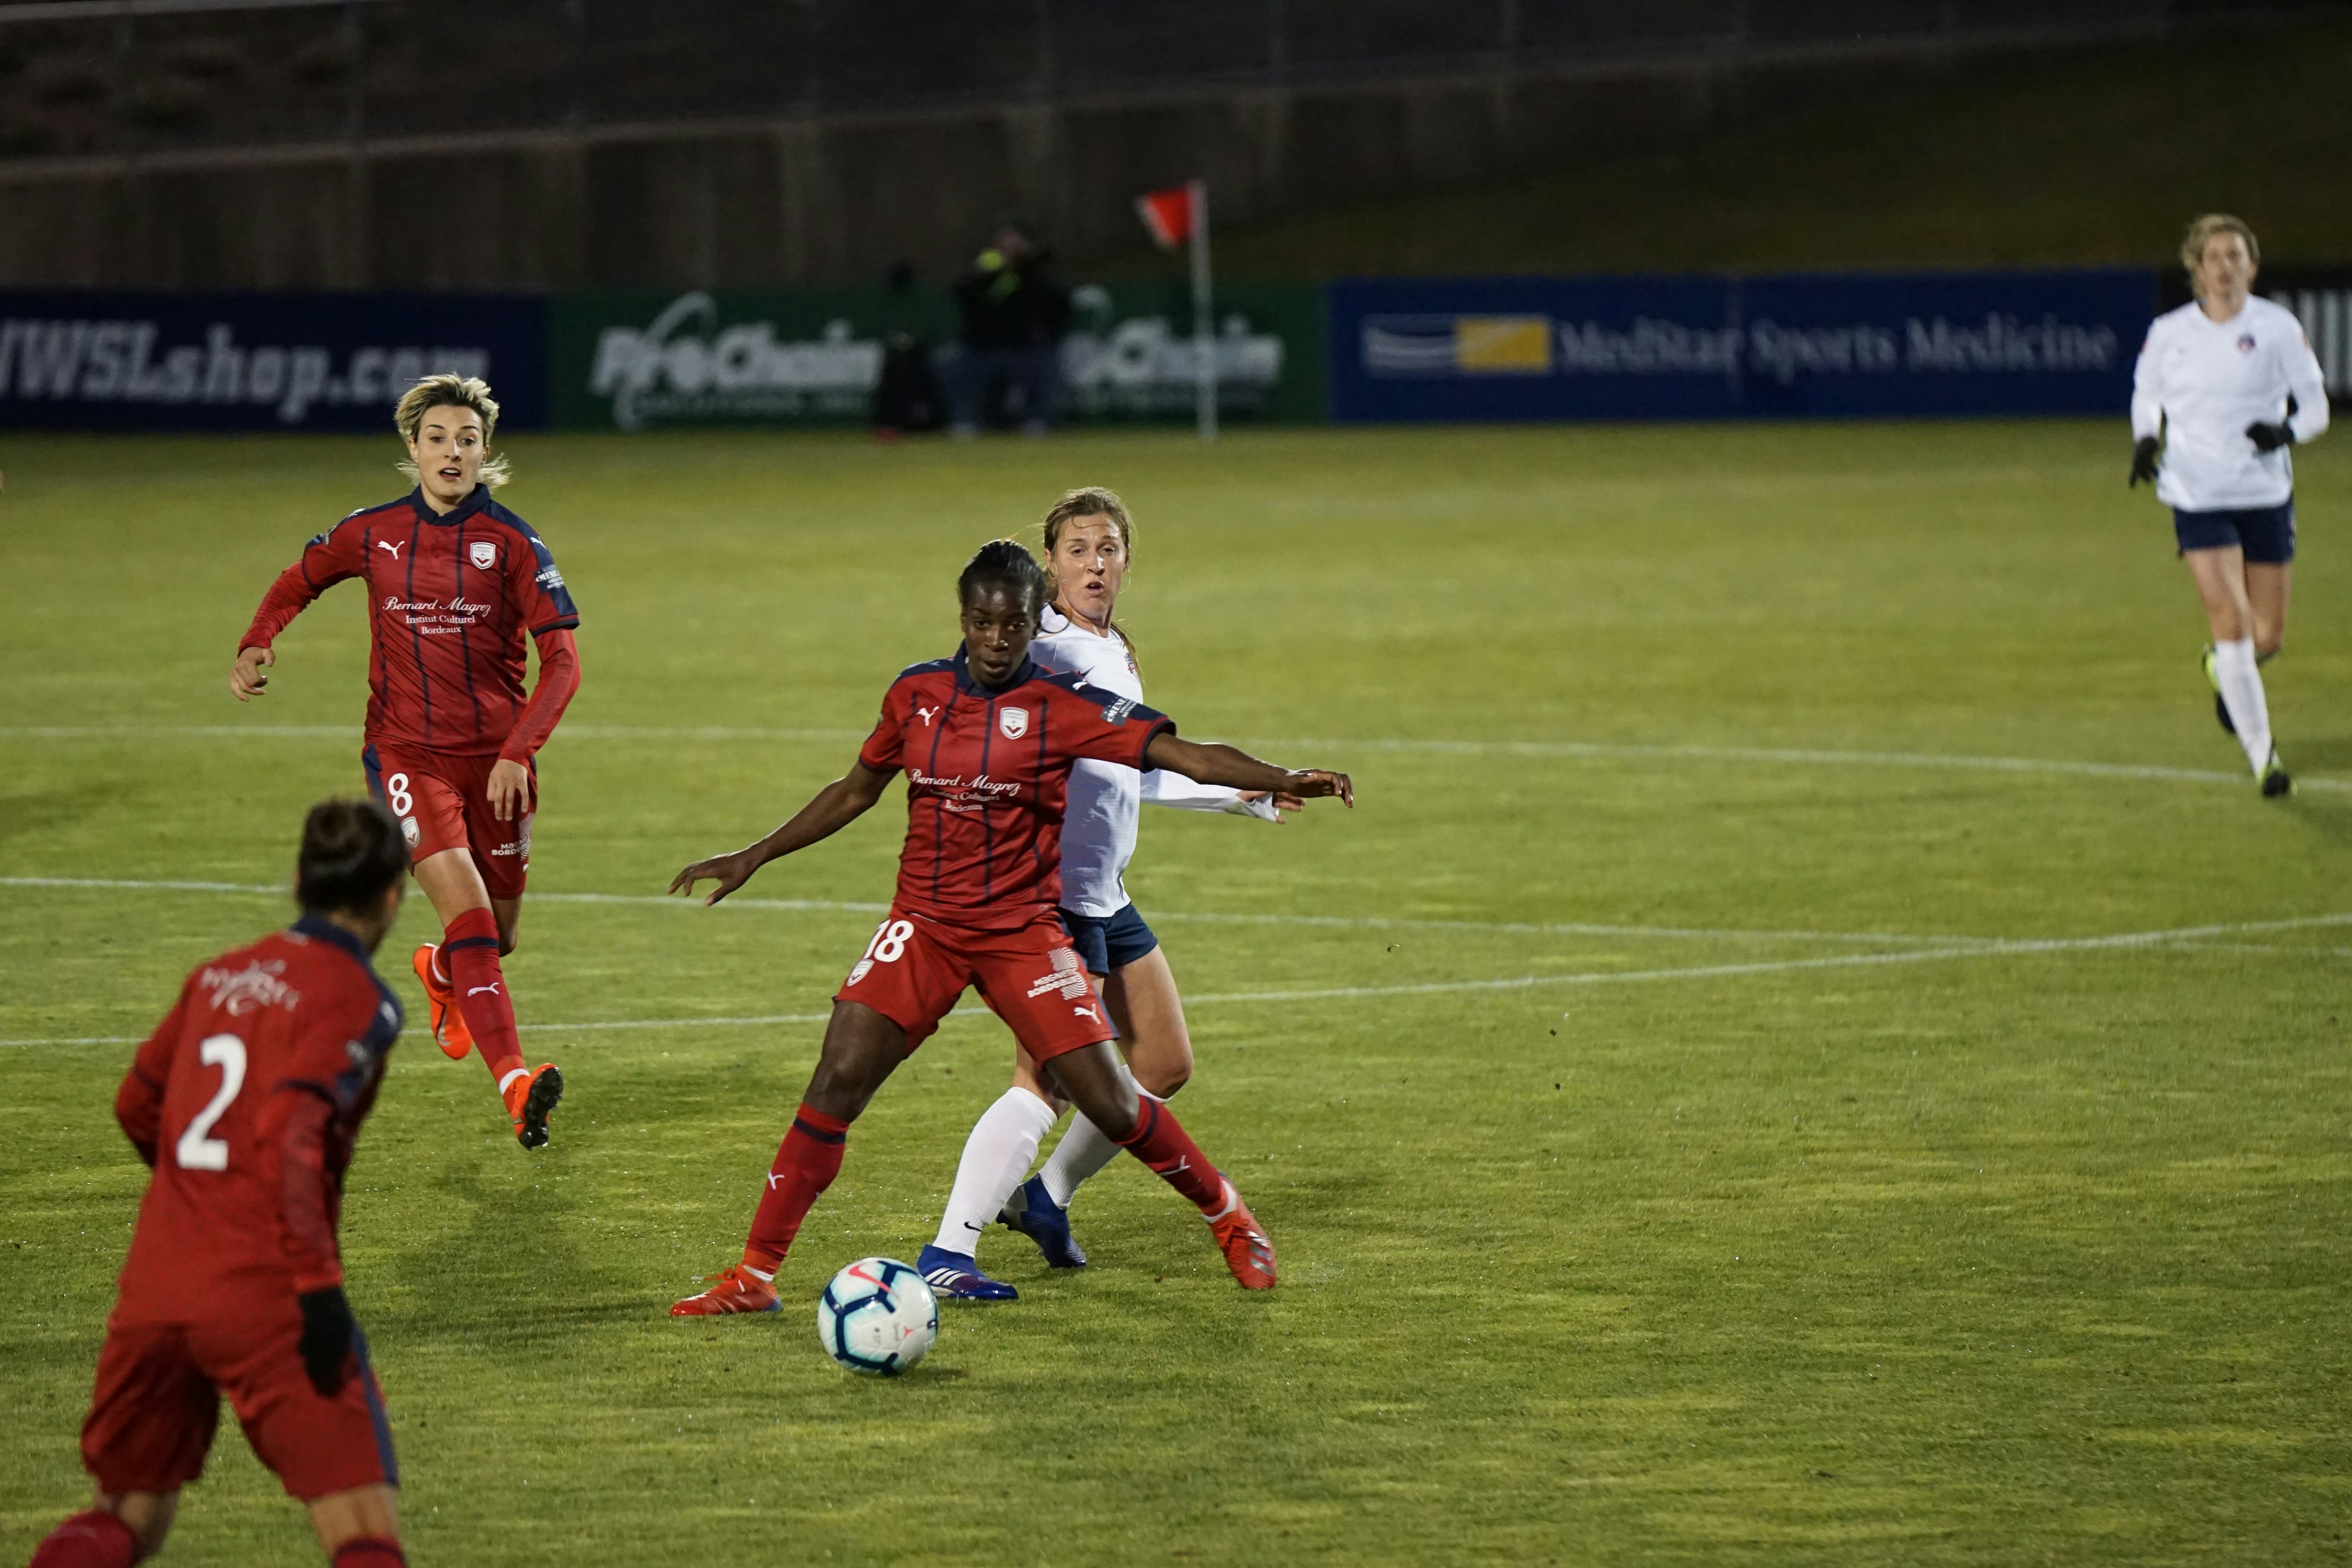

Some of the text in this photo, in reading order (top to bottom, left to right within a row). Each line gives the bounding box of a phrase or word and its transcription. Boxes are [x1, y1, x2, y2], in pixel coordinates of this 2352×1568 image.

[1750, 317, 1898, 386] Sports
[1906, 311, 2118, 372] Medicine
[383, 597, 493, 617] Bernard Magrez
[405, 615, 475, 624] Institut Culturel
[421, 626, 461, 634] Bordeaux
[388, 773, 413, 817] 8
[961, 775, 1022, 797] Magrez
[863, 918, 915, 962] 18
[177, 1033, 247, 1171] 2
